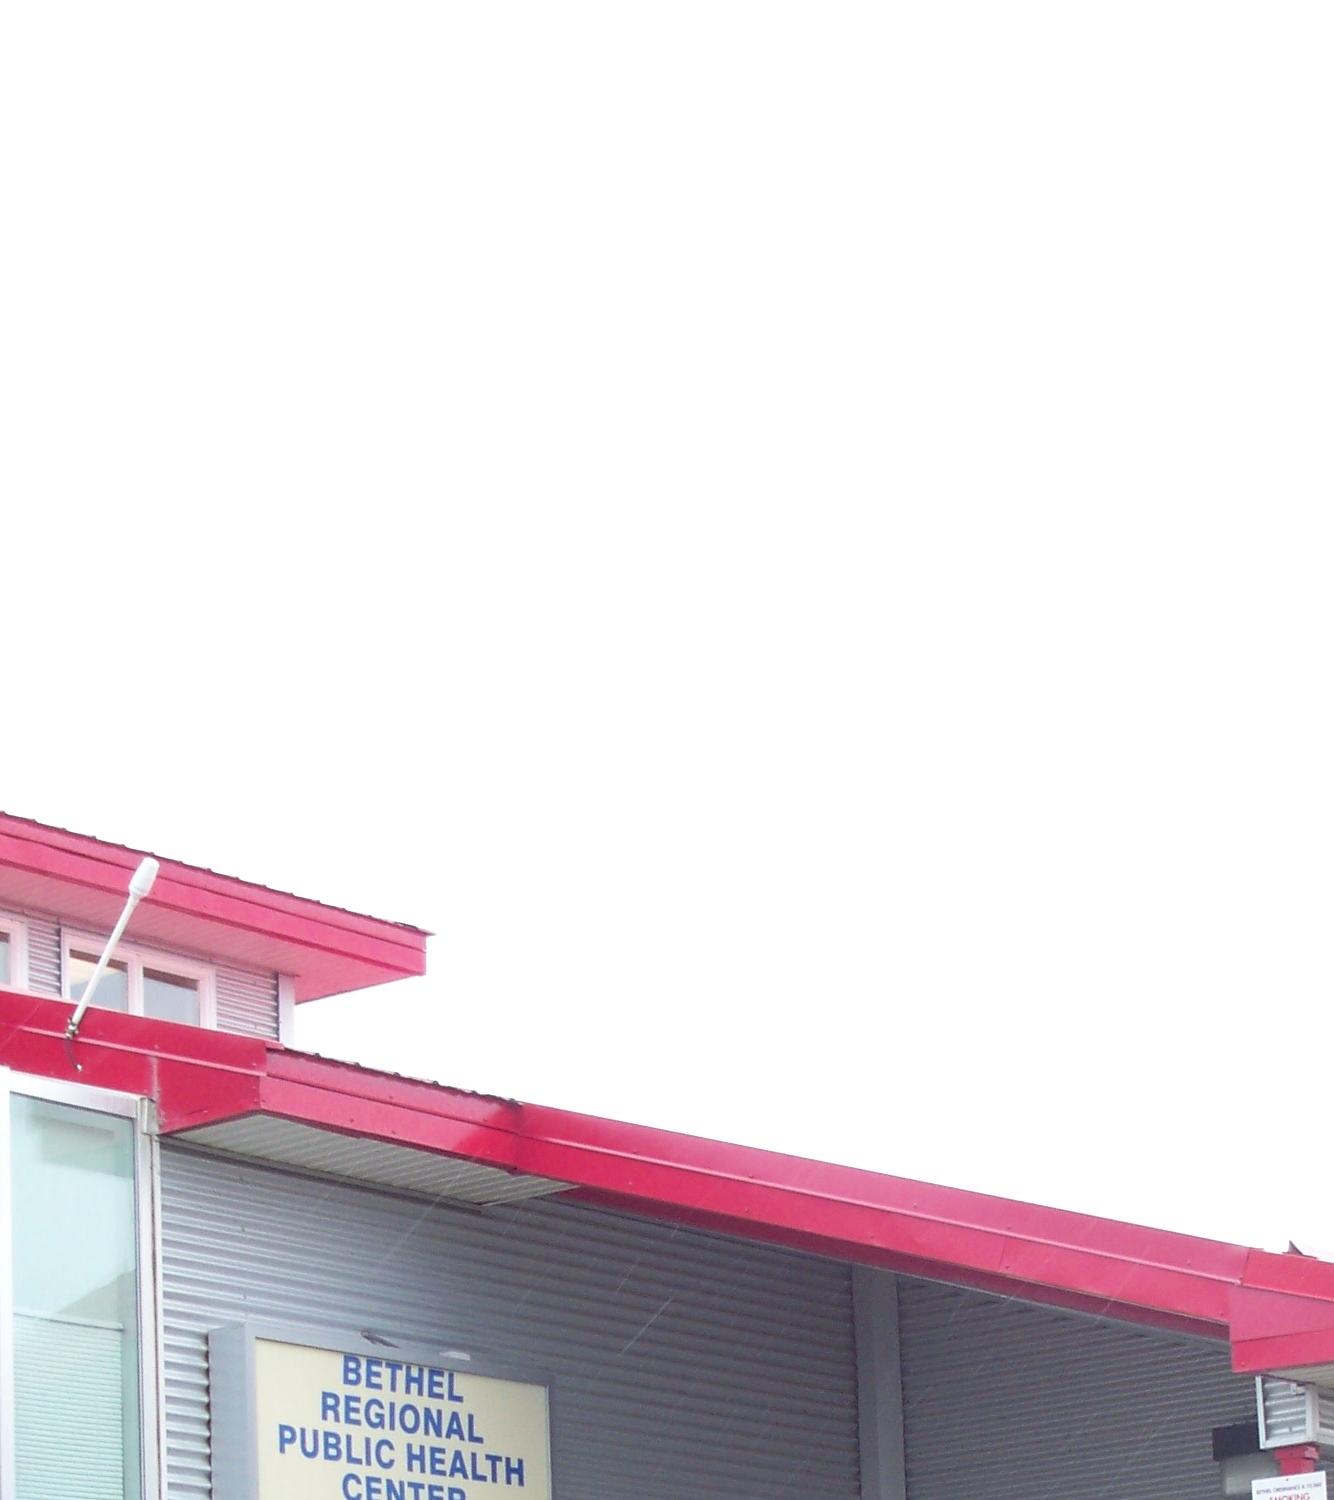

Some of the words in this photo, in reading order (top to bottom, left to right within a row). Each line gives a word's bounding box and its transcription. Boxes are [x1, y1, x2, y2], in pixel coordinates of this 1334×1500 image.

[343, 1355, 464, 1403] BETHEL
[321, 1391, 484, 1444] REGIONAL
[278, 1424, 395, 1469] PUBLIC
[406, 1443, 525, 1487] HEALTH
